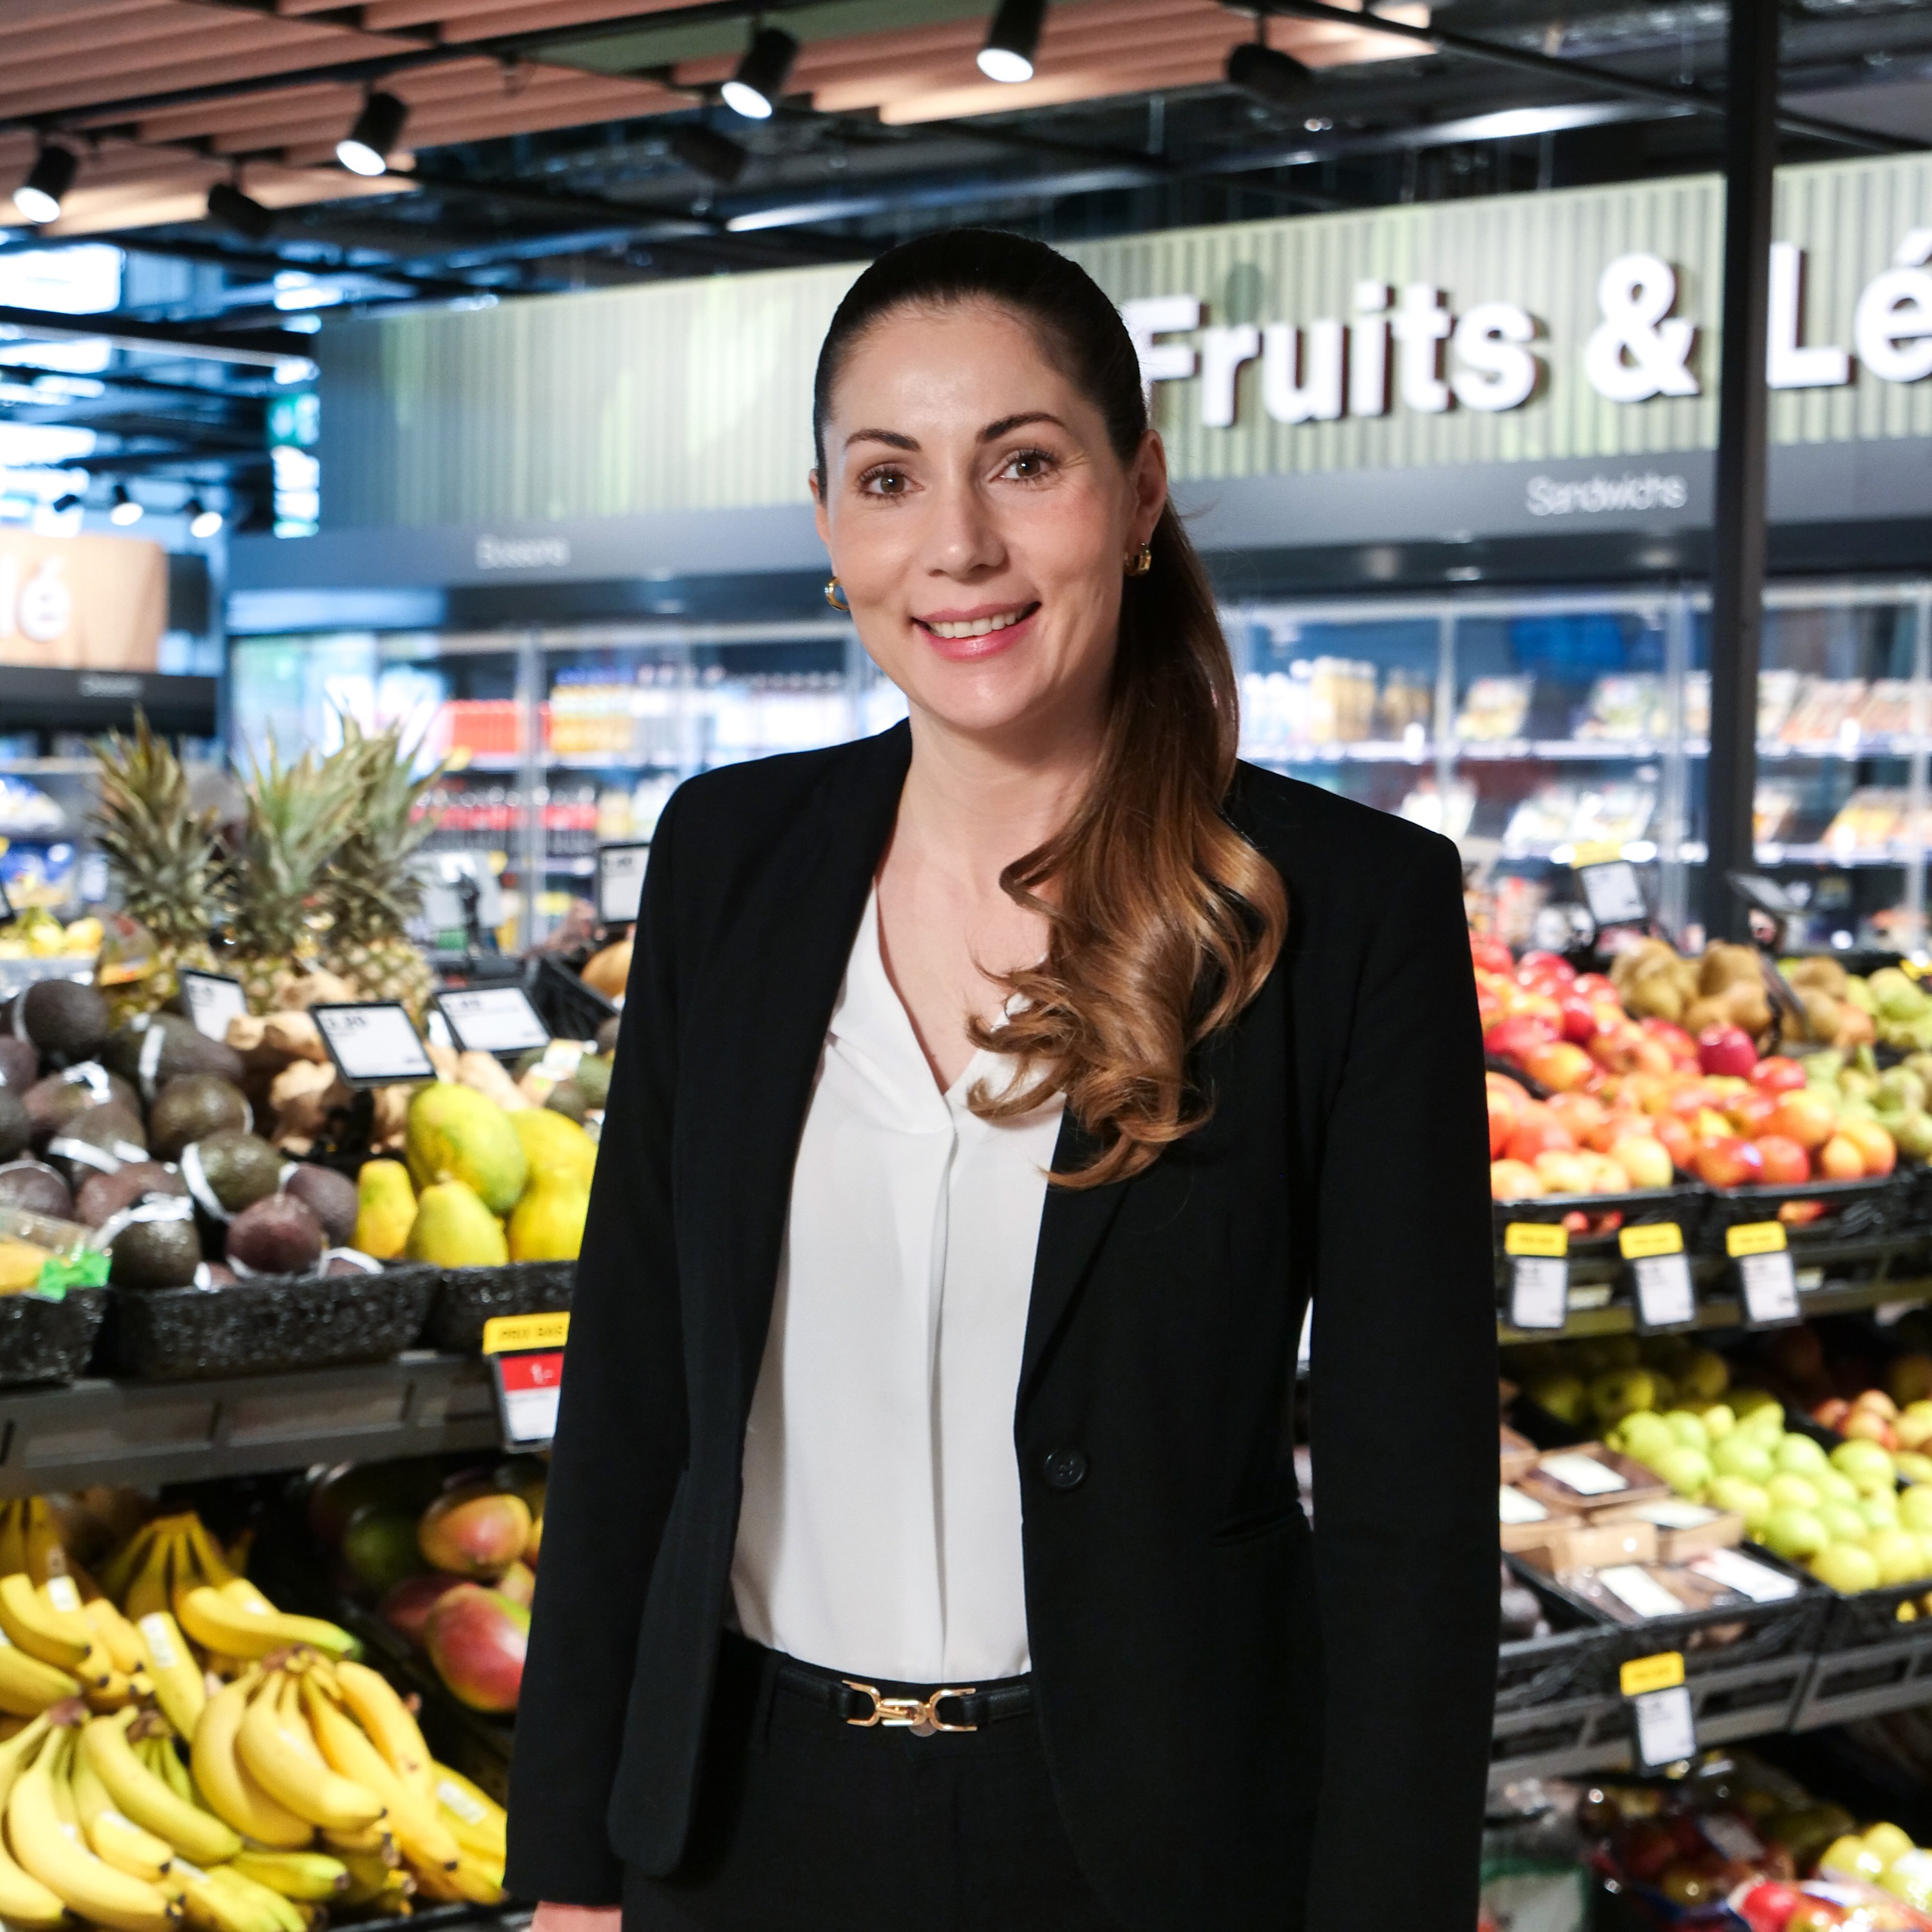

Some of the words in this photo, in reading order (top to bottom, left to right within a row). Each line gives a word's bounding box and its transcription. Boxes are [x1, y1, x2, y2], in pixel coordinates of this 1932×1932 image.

[1122, 281, 1537, 428] Fruits
[1587, 252, 1701, 402] &
[1766, 225, 1932, 389] Lé
[1526, 472, 1687, 515] Sandwichs
